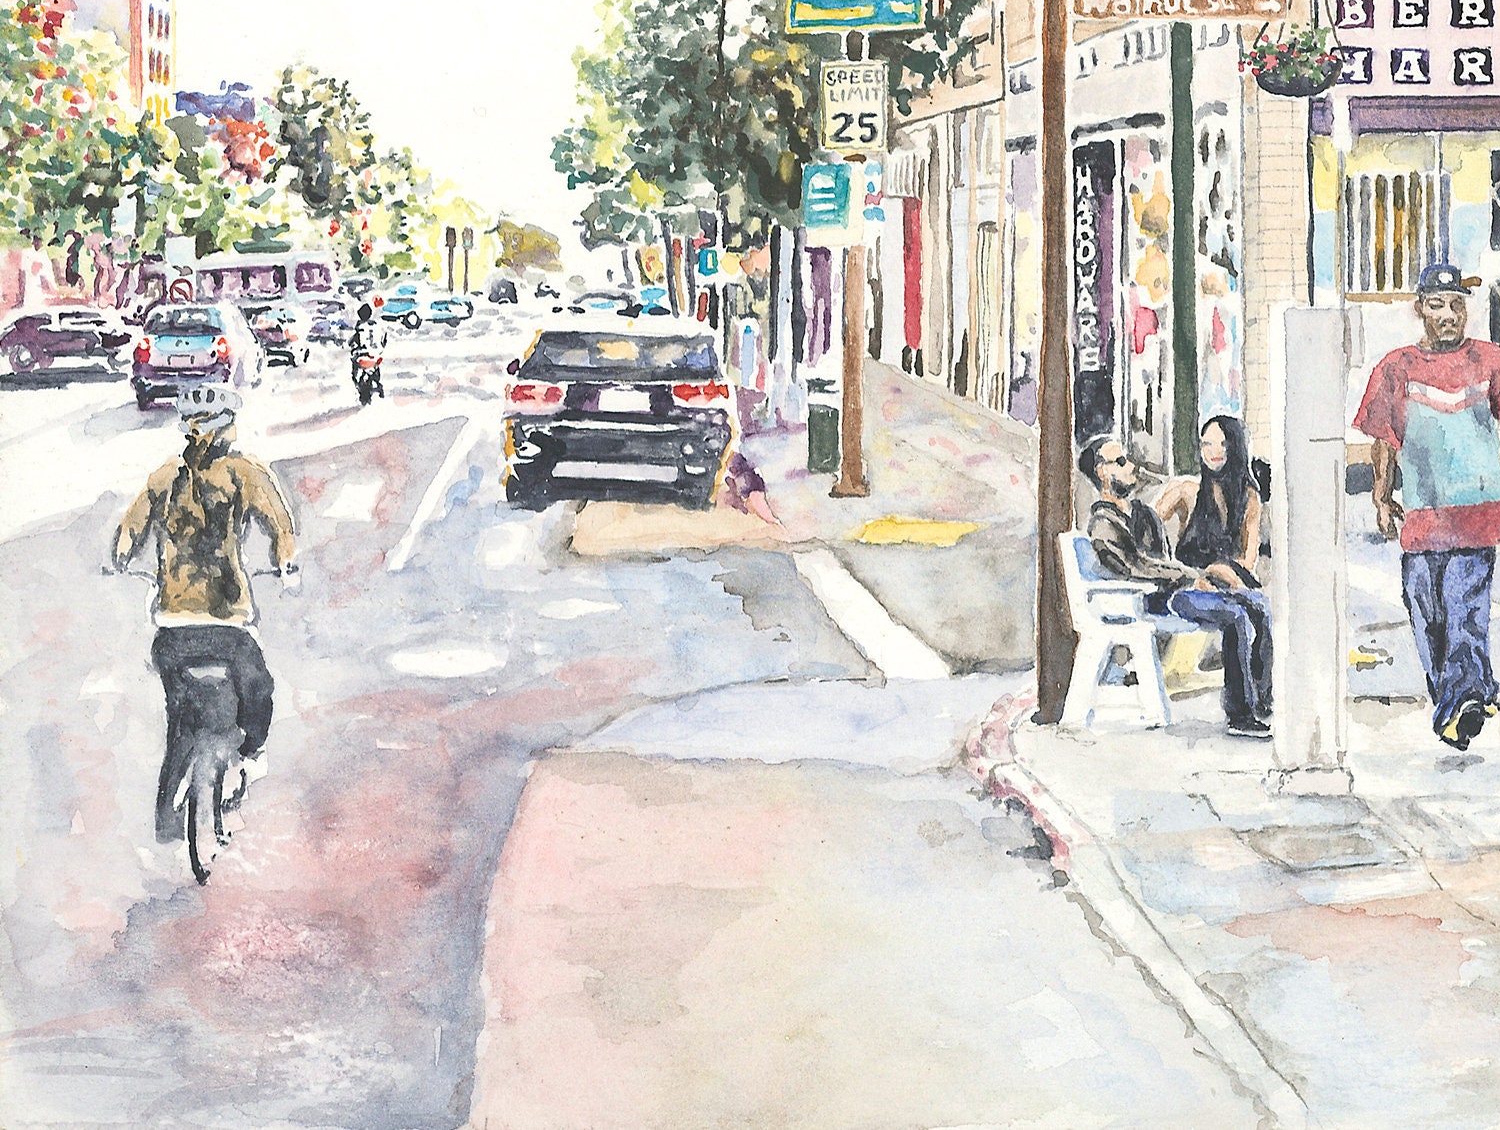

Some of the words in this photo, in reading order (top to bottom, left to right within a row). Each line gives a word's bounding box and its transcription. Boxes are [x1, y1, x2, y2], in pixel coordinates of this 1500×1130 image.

[825, 69, 885, 86] SPEED
[829, 88, 881, 103] LIMIT
[830, 112, 878, 143] 25
